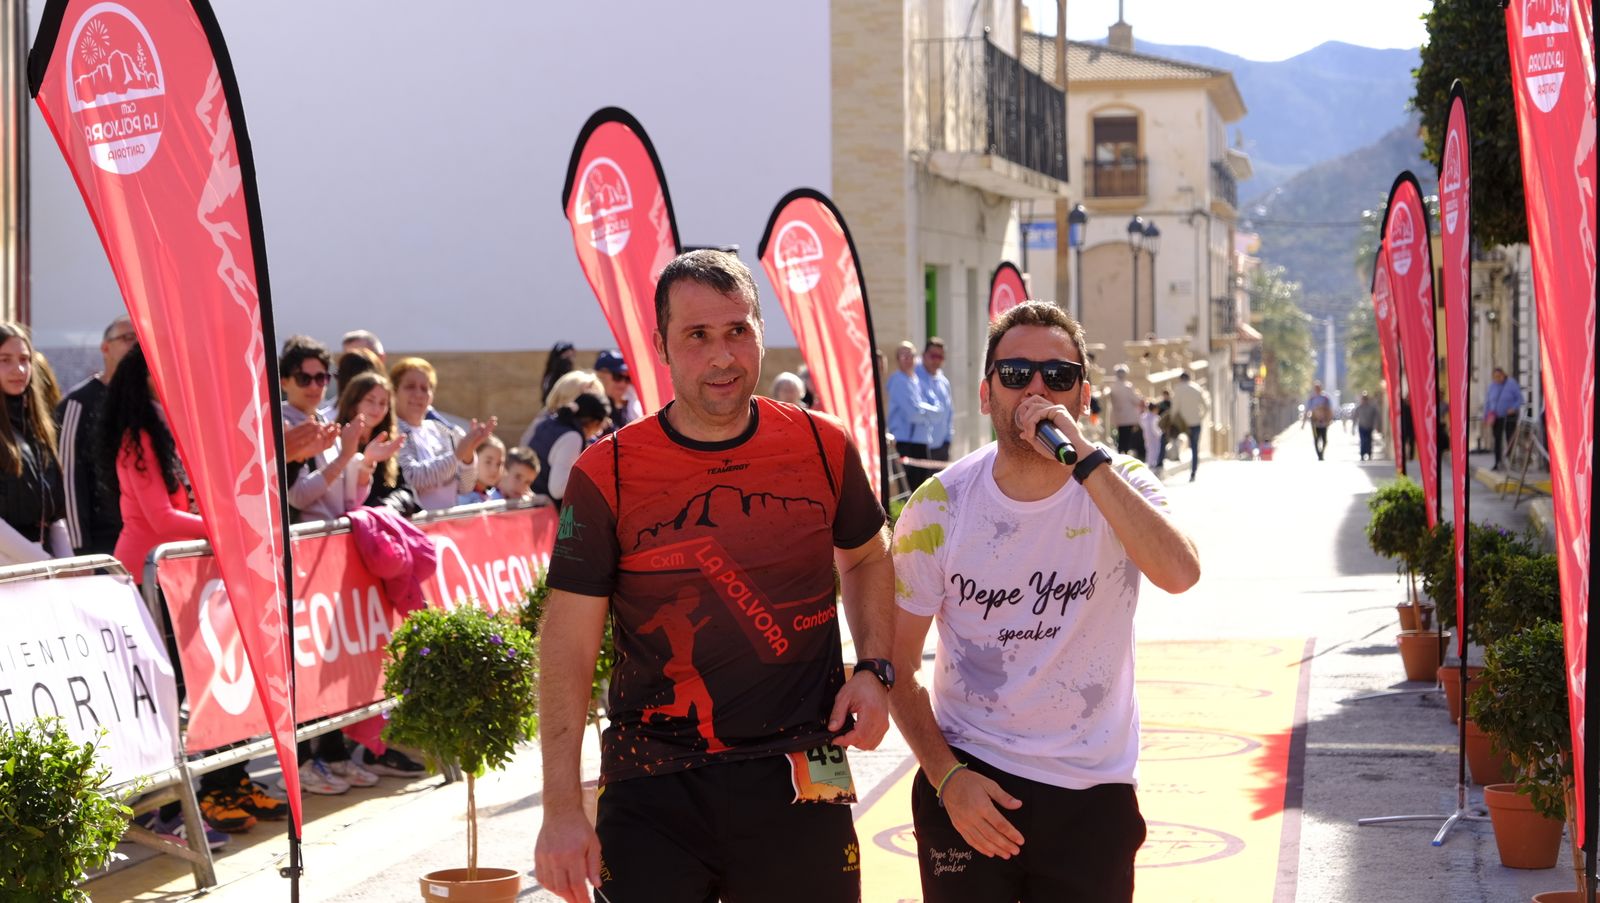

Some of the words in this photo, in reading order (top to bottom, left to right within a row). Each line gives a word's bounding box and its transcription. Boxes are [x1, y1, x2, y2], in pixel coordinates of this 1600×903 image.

[695, 544, 724, 575] LA
[950, 573, 1024, 620] Pepe
[1028, 571, 1098, 616] Yepes
[0, 633, 89, 672] IENTO
[100, 625, 137, 653] DE
[292, 585, 391, 667] EOLIA
[997, 621, 1061, 647] speaker
[0, 664, 157, 738] TORIA
